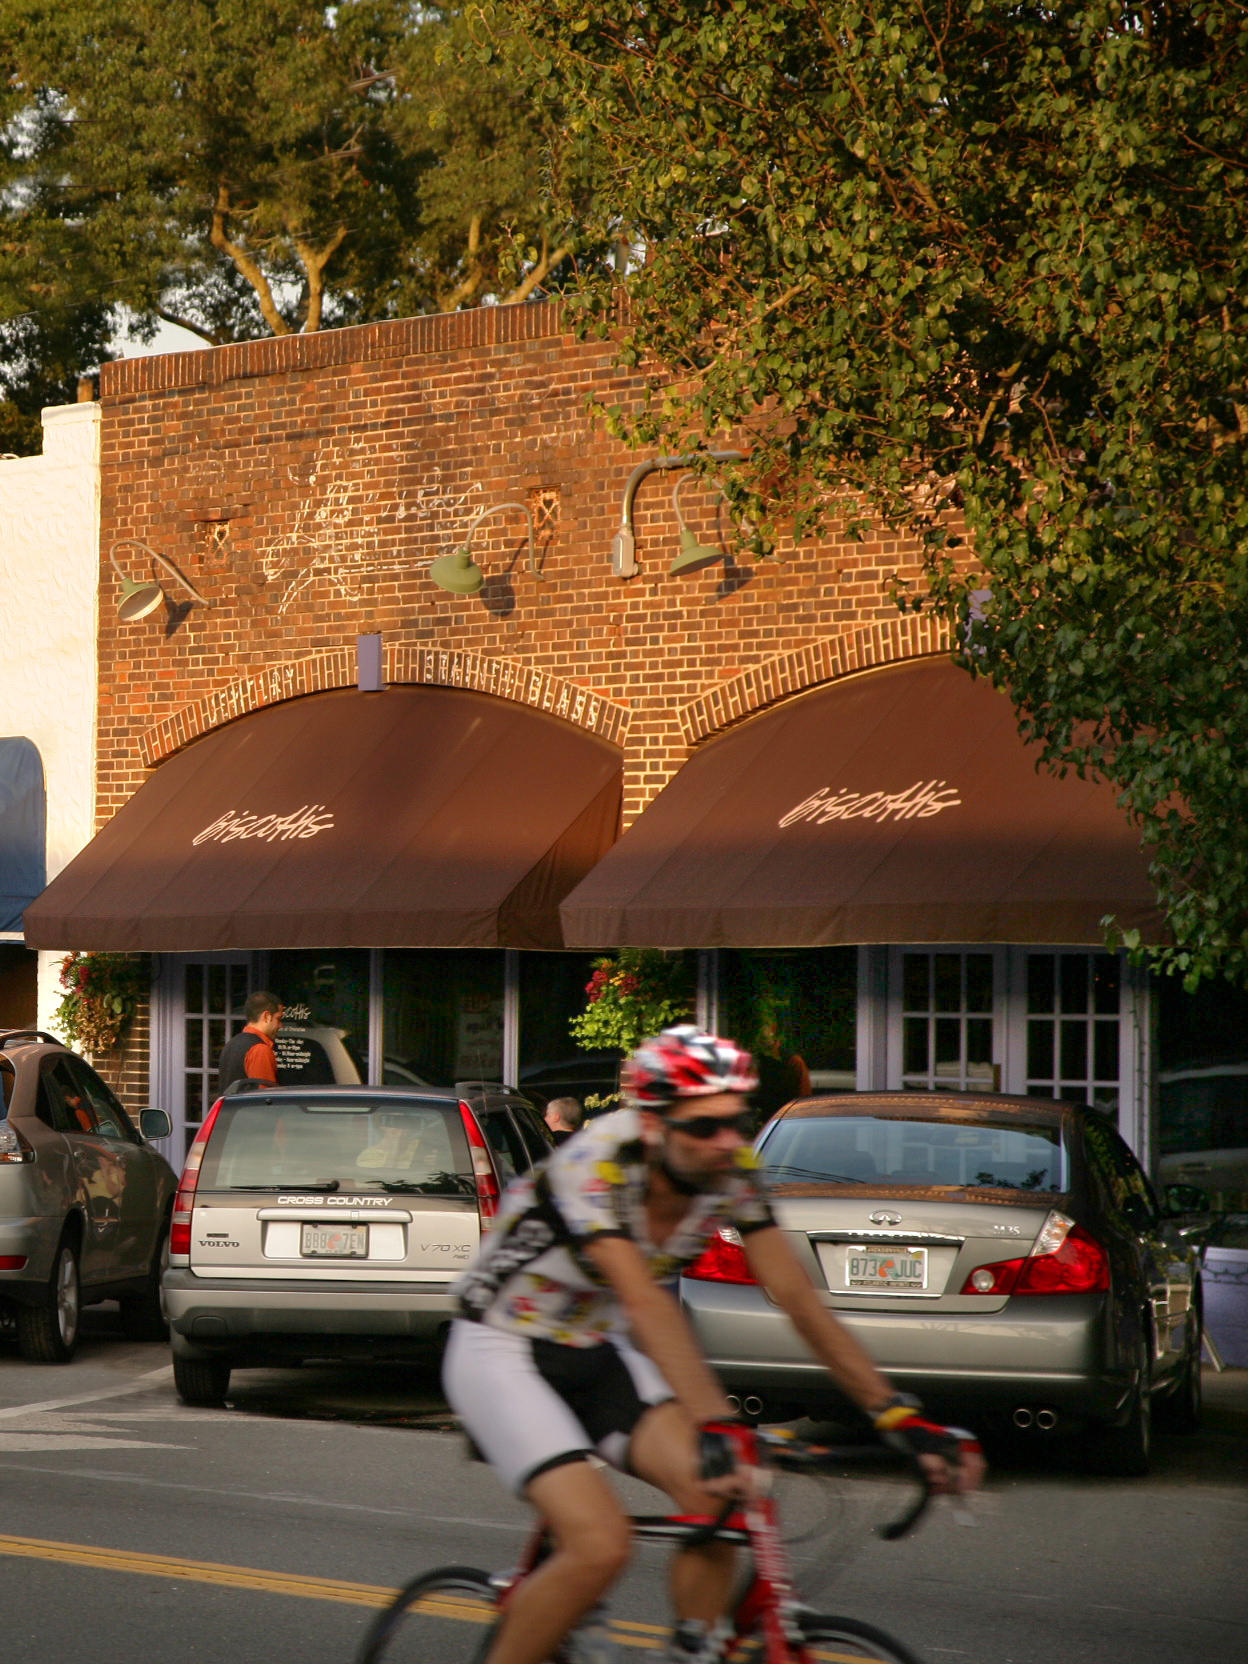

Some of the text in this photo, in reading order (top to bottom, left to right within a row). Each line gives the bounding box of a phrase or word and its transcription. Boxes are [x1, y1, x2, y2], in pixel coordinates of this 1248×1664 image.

[277, 1195, 394, 1206] CROSS COUNTRY
[198, 1240, 240, 1248] VOLVO
